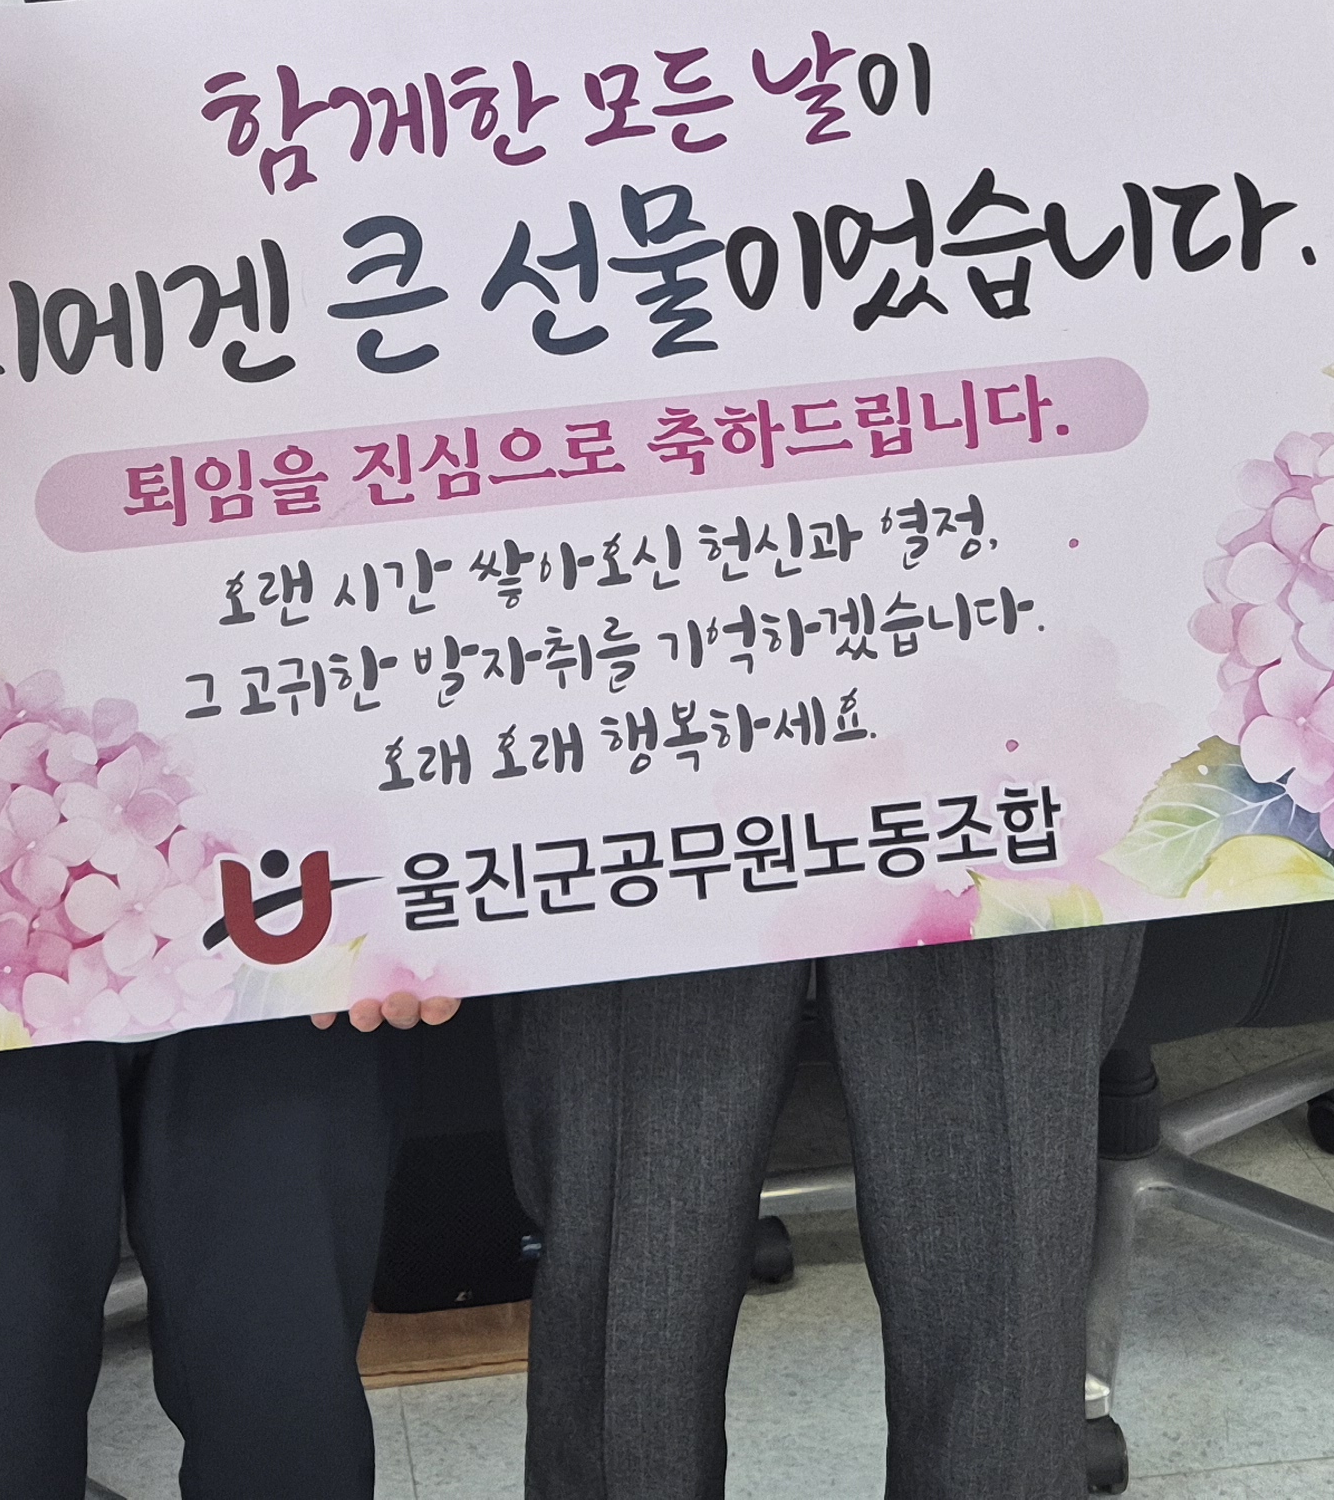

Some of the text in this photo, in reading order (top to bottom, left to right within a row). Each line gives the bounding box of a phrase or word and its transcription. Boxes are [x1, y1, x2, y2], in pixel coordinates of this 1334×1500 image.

[201, 30, 931, 196] 함께한 모든 날이
[327, 214, 449, 375] 큰
[480, 166, 1318, 359] 선물이었습니다.
[122, 373, 1071, 528] 퇴임을 진심으로 축하드립니다.
[218, 493, 998, 628] 오랜 시간 쌓아오신 헌신과 열정,
[184, 586, 1046, 720] 그 고귀한 발자취를 기억하겠습니다.
[377, 687, 878, 793] 오래 오래 행복하세요.
[394, 783, 1063, 932] 울진군공무원노동조합
